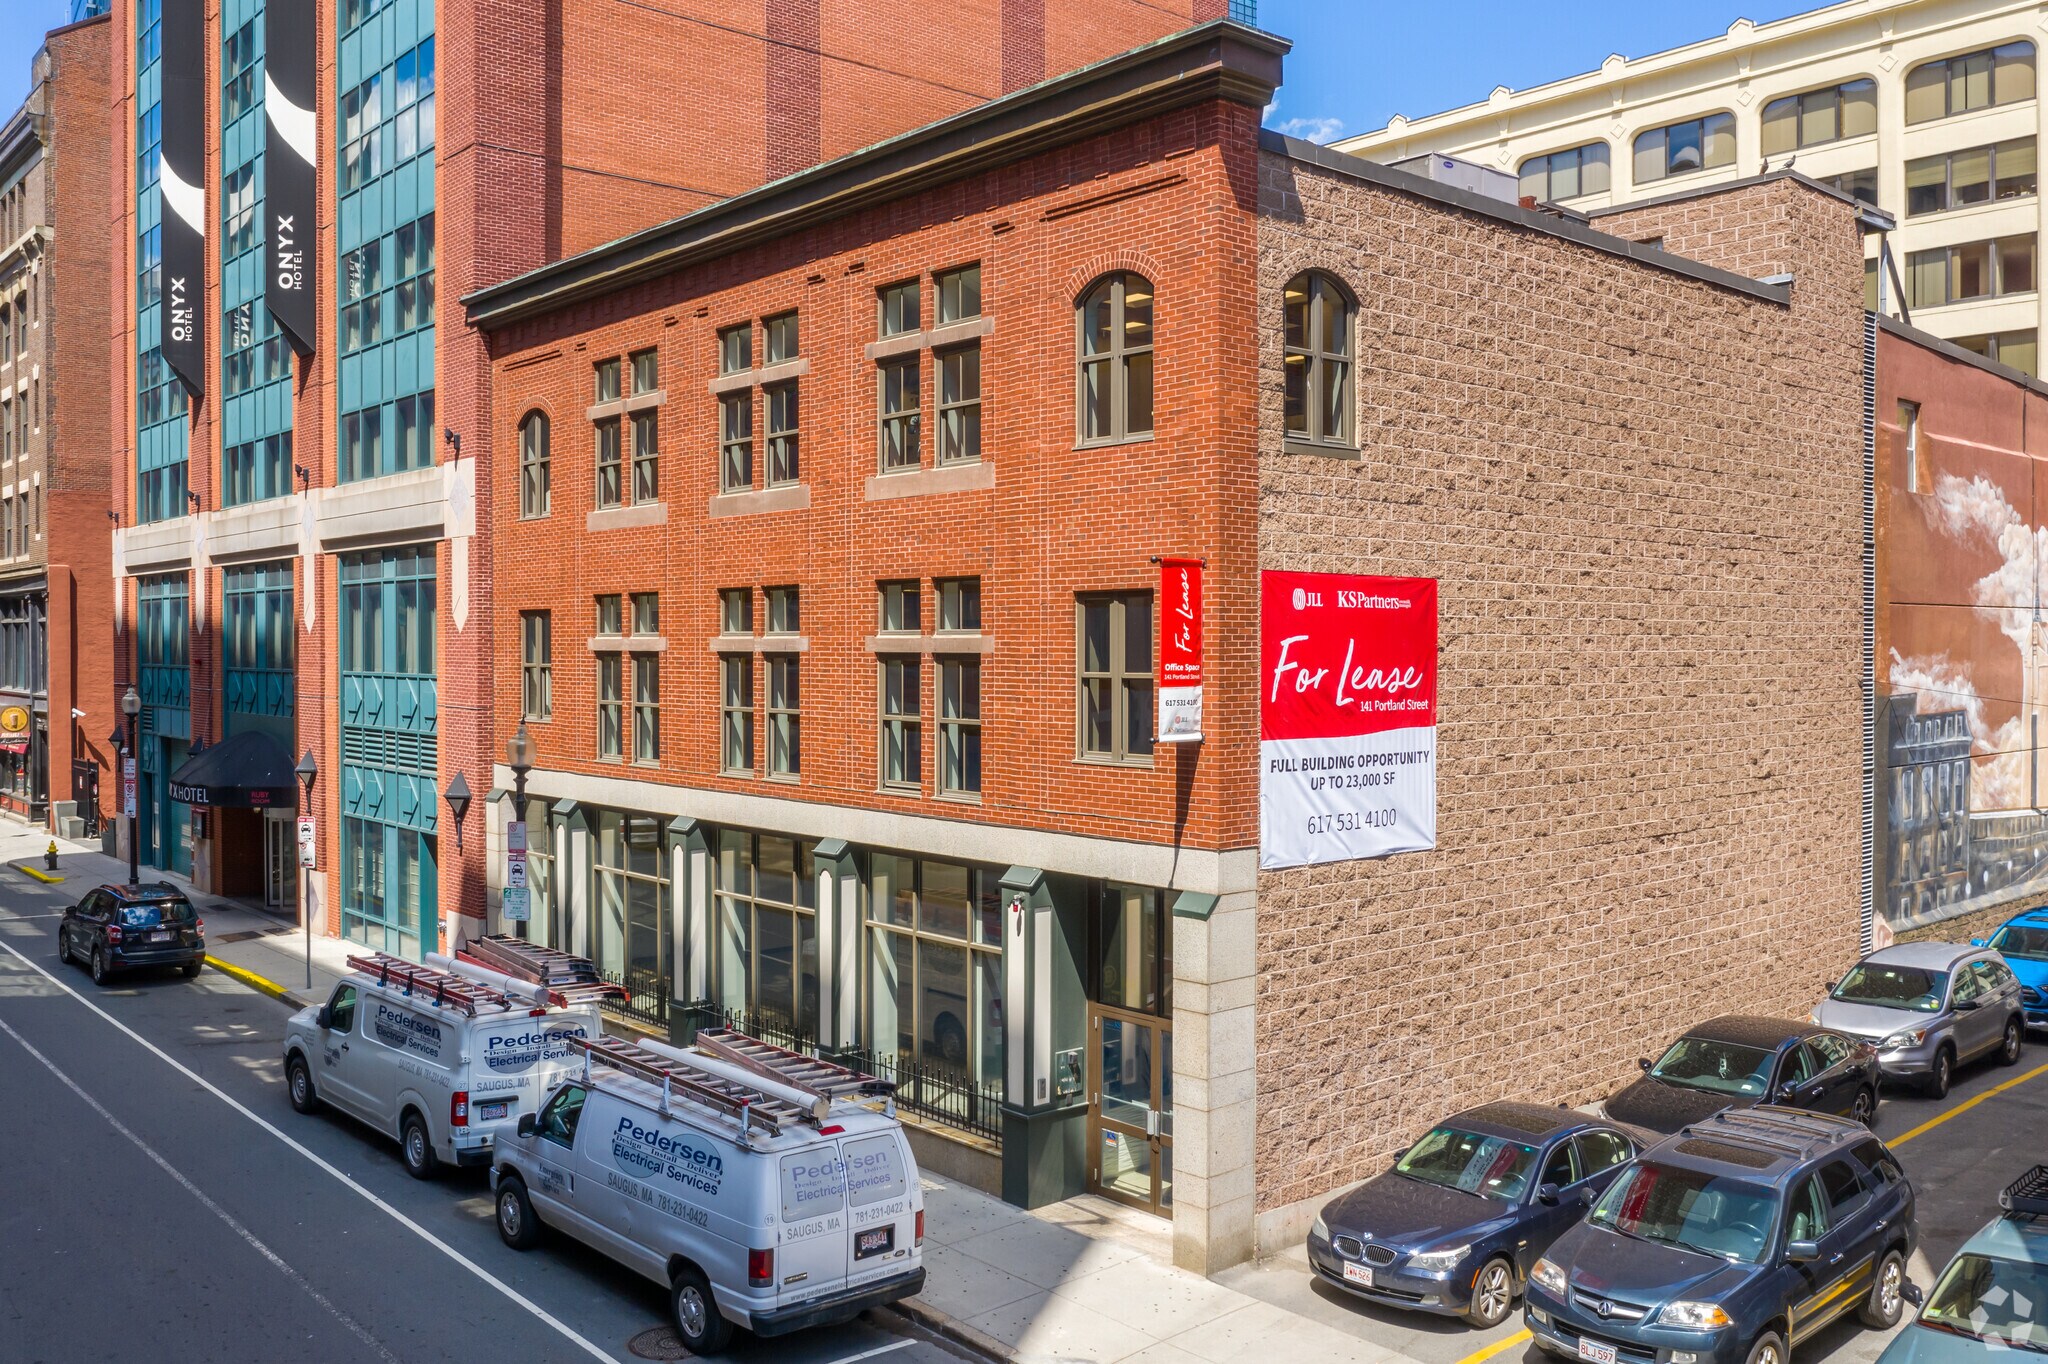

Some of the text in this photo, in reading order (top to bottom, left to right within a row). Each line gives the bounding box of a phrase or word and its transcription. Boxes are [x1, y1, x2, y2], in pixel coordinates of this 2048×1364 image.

[278, 215, 294, 289] ONYX
[293, 250, 303, 290] HOTEL
[171, 277, 186, 341] ONYX
[185, 307, 193, 342] HOTEL
[1174, 567, 1194, 653] For Lease
[1305, 592, 1324, 607] JLL
[1165, 663, 1184, 671] Office
[1271, 635, 1423, 707] For Lease
[1360, 698, 1429, 712] 141 Portland Street
[1270, 750, 1430, 773] FULL BUILDING OPPORTUNITY
[178, 786, 209, 803] HOTEL
[1310, 771, 1396, 791] UP TO 23,000 SF
[1307, 808, 1397, 835] 617 531 4100
[378, 1004, 440, 1039] Pedersen
[376, 1025, 439, 1058] Electrical Services
[489, 1028, 585, 1050] Pedersen
[490, 1048, 517, 1056] Design
[489, 1051, 540, 1068] Electrical
[518, 1077, 530, 1089] MA
[616, 1134, 719, 1179] Design Install Deliver
[618, 1116, 722, 1171] Pedersen
[613, 1144, 718, 1196] Electrical Services
[849, 1173, 891, 1191] Services
[642, 1186, 653, 1204] MA
[658, 1194, 709, 1227] 781-231-0422
[827, 1217, 840, 1230] MA
[855, 1201, 903, 1223] 781-231-0422
[1580, 1344, 1613, 1362] 8LJ 597
